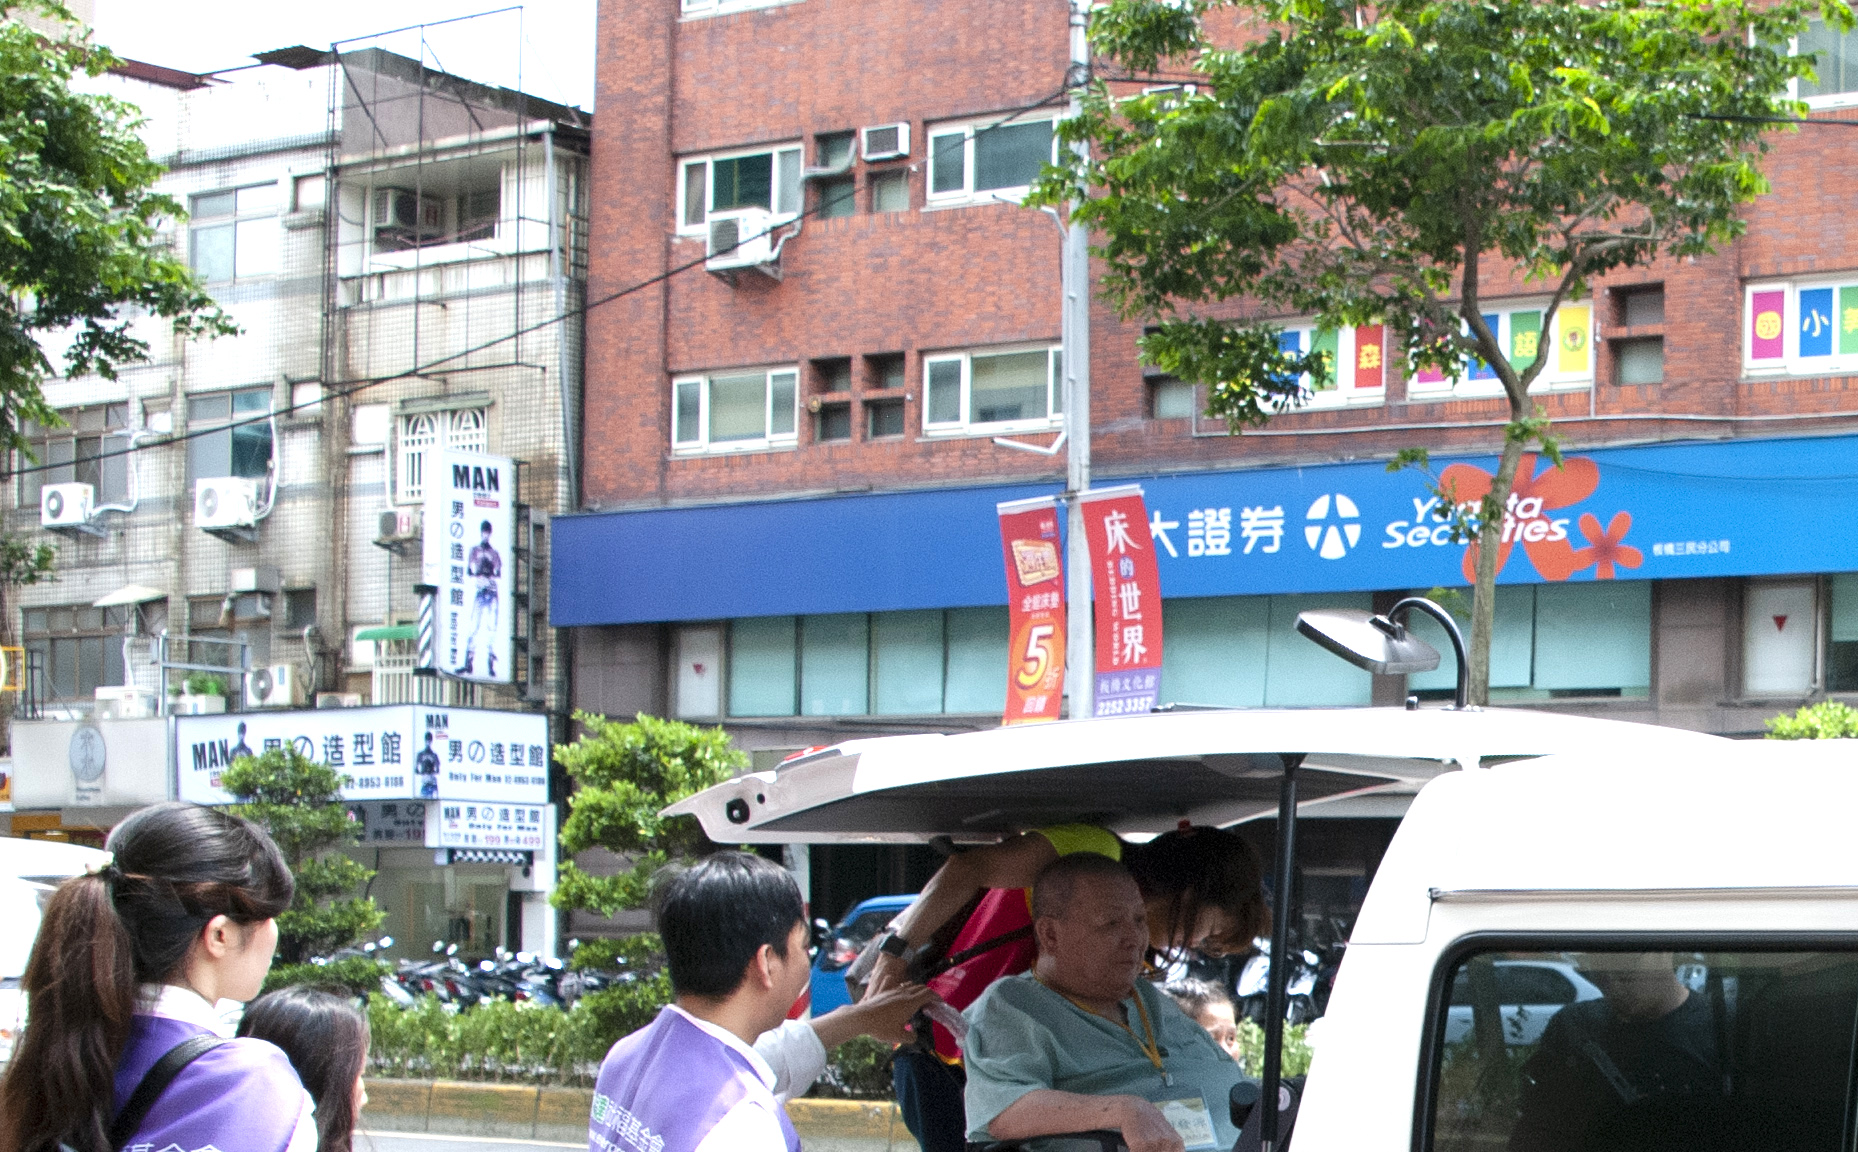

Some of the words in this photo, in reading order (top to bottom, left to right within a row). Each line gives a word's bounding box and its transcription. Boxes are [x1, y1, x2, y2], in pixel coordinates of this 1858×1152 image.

[452, 464, 499, 491] MAN
[1412, 492, 1544, 523] Yuata
[1150, 505, 1285, 557] 大證券
[1382, 518, 1570, 549] Secuties
[449, 500, 465, 607] 男の造型館
[1103, 510, 1148, 665] 床的世界
[425, 714, 449, 729] MAN
[192, 738, 232, 771] MAN
[448, 739, 544, 767] 男の造型館
